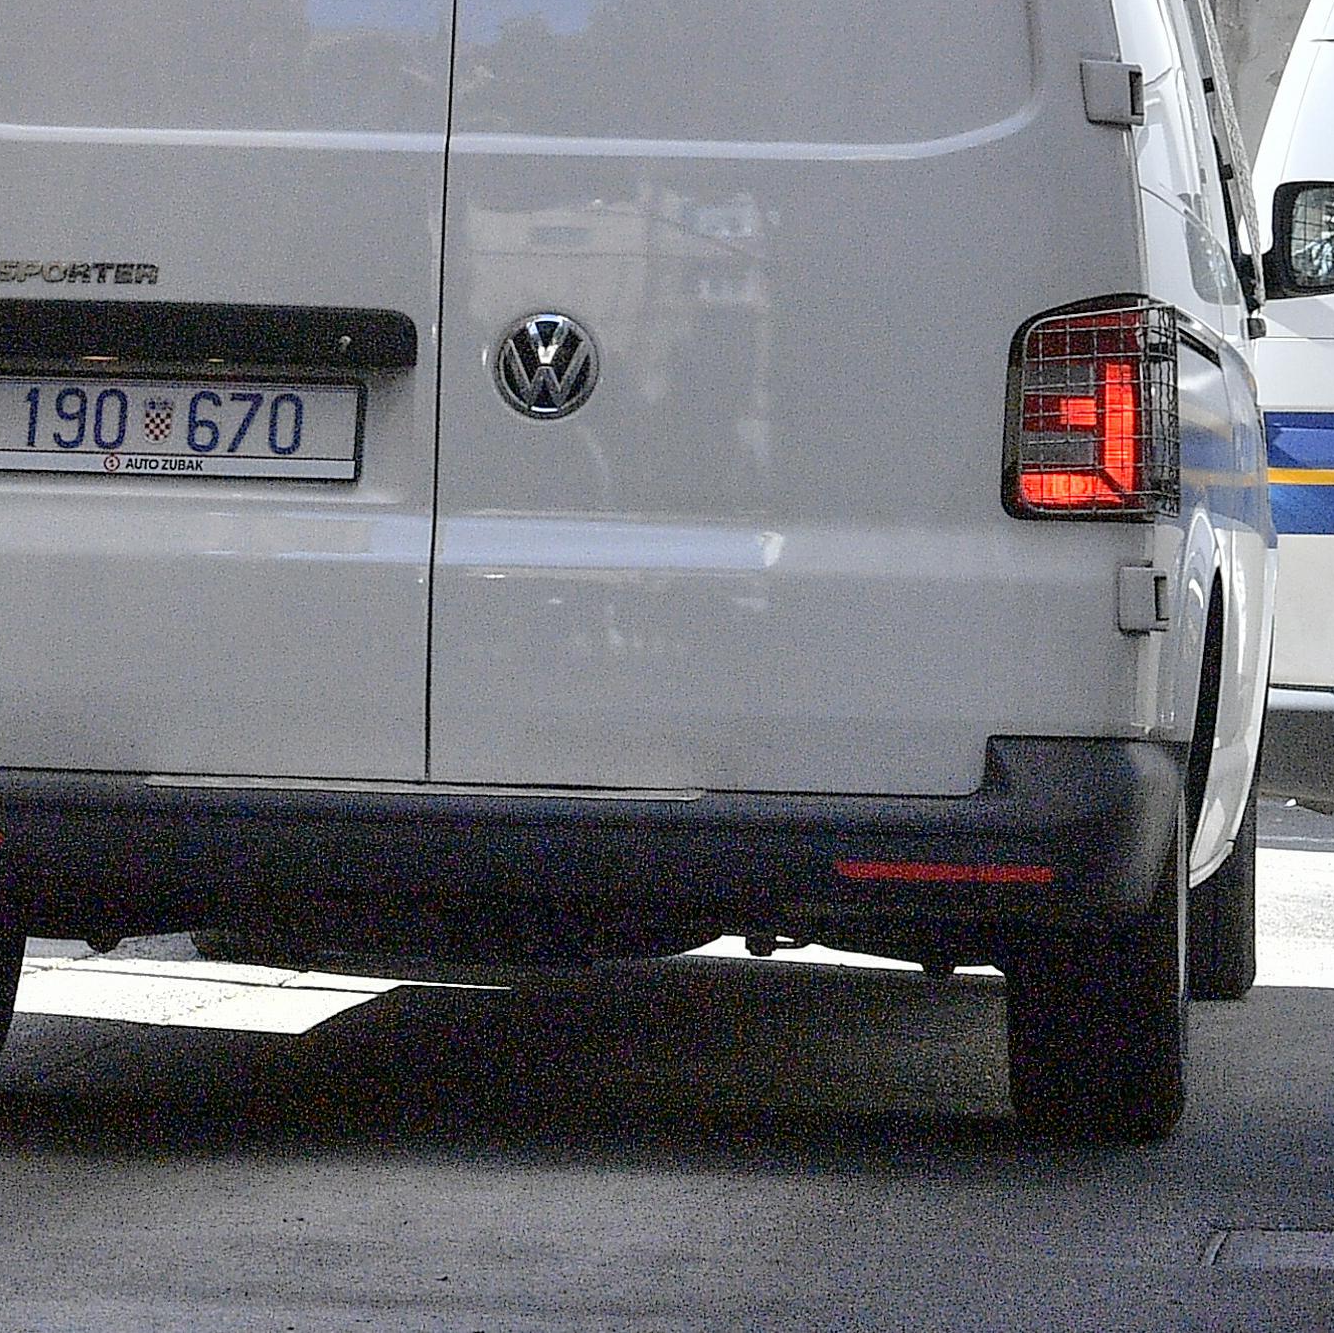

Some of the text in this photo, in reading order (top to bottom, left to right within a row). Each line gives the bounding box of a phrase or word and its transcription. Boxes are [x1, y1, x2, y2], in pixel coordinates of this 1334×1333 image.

[25, 386, 303, 455] 190 670
[125, 457, 204, 472] AUTO ZUBAK
